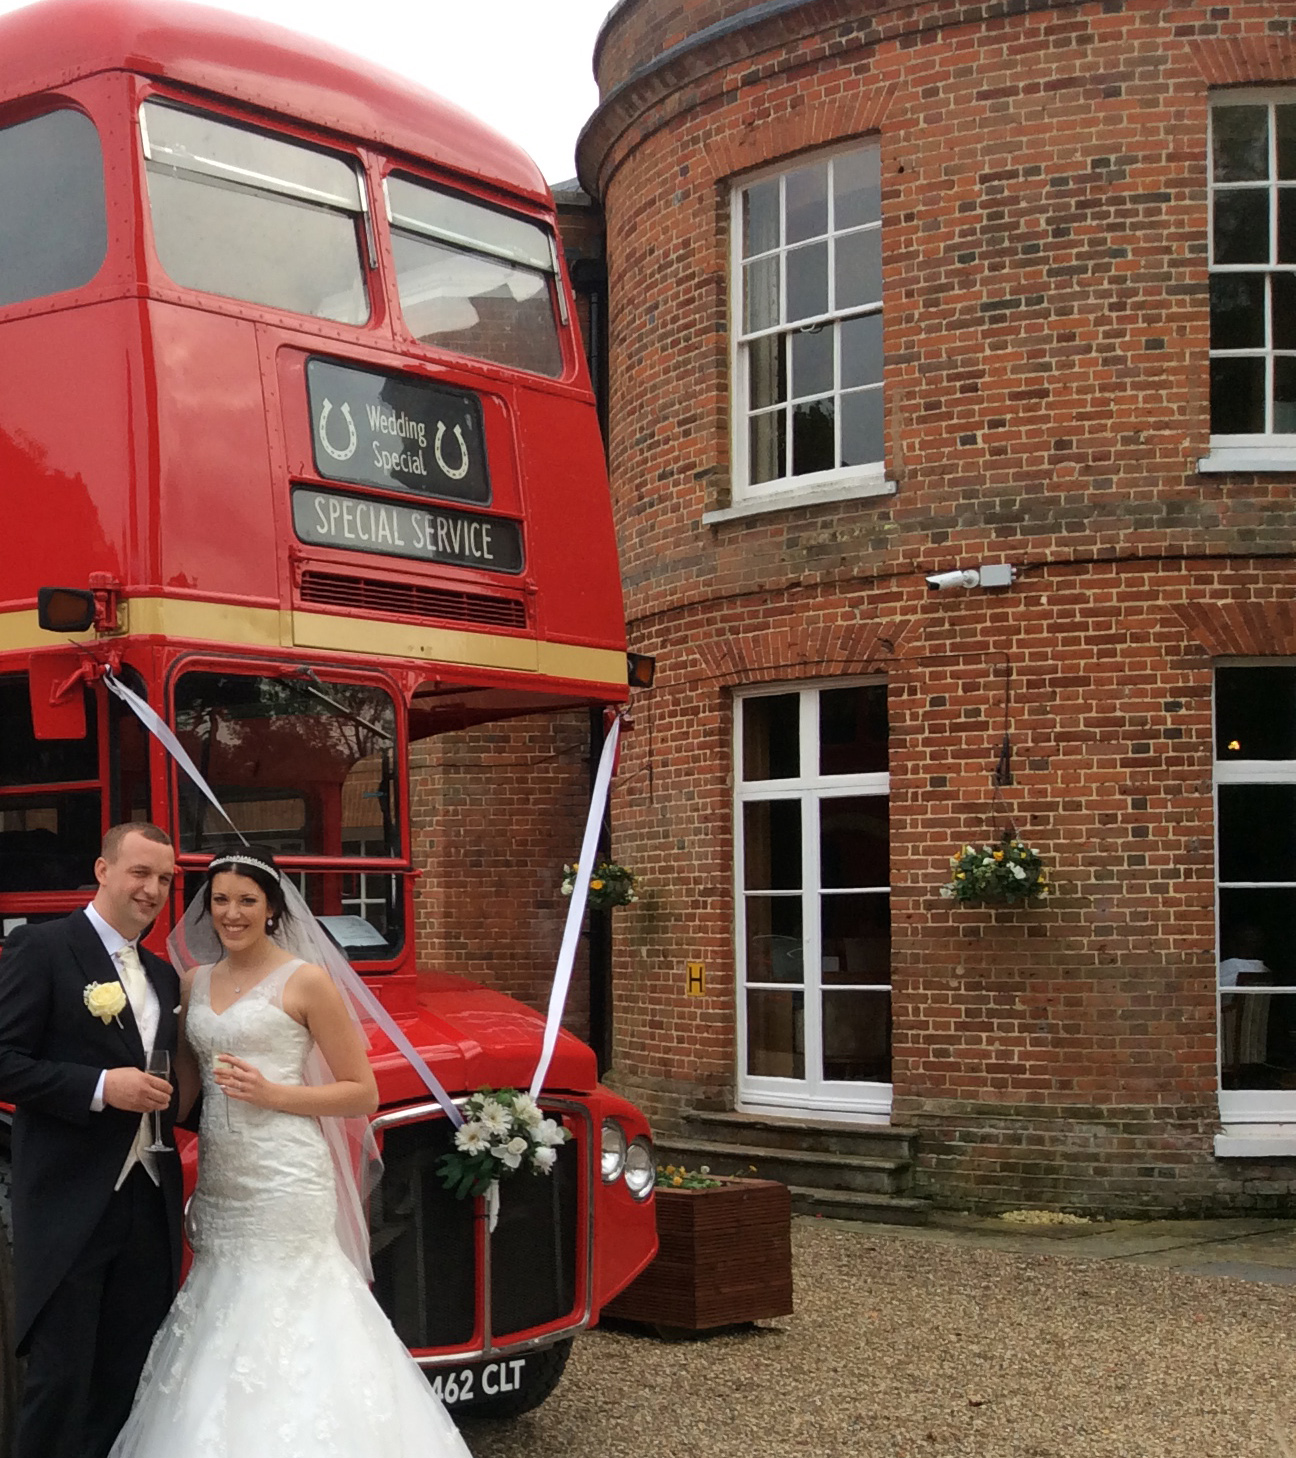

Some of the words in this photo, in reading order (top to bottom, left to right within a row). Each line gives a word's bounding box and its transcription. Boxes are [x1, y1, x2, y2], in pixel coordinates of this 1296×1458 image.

[365, 403, 427, 448] Wedding
[372, 441, 428, 476] Special
[314, 497, 405, 546] SPECIAL
[411, 513, 494, 560] SERVICE
[689, 966, 703, 993] H
[432, 1369, 474, 1404] 462
[482, 1359, 526, 1395] CLT
